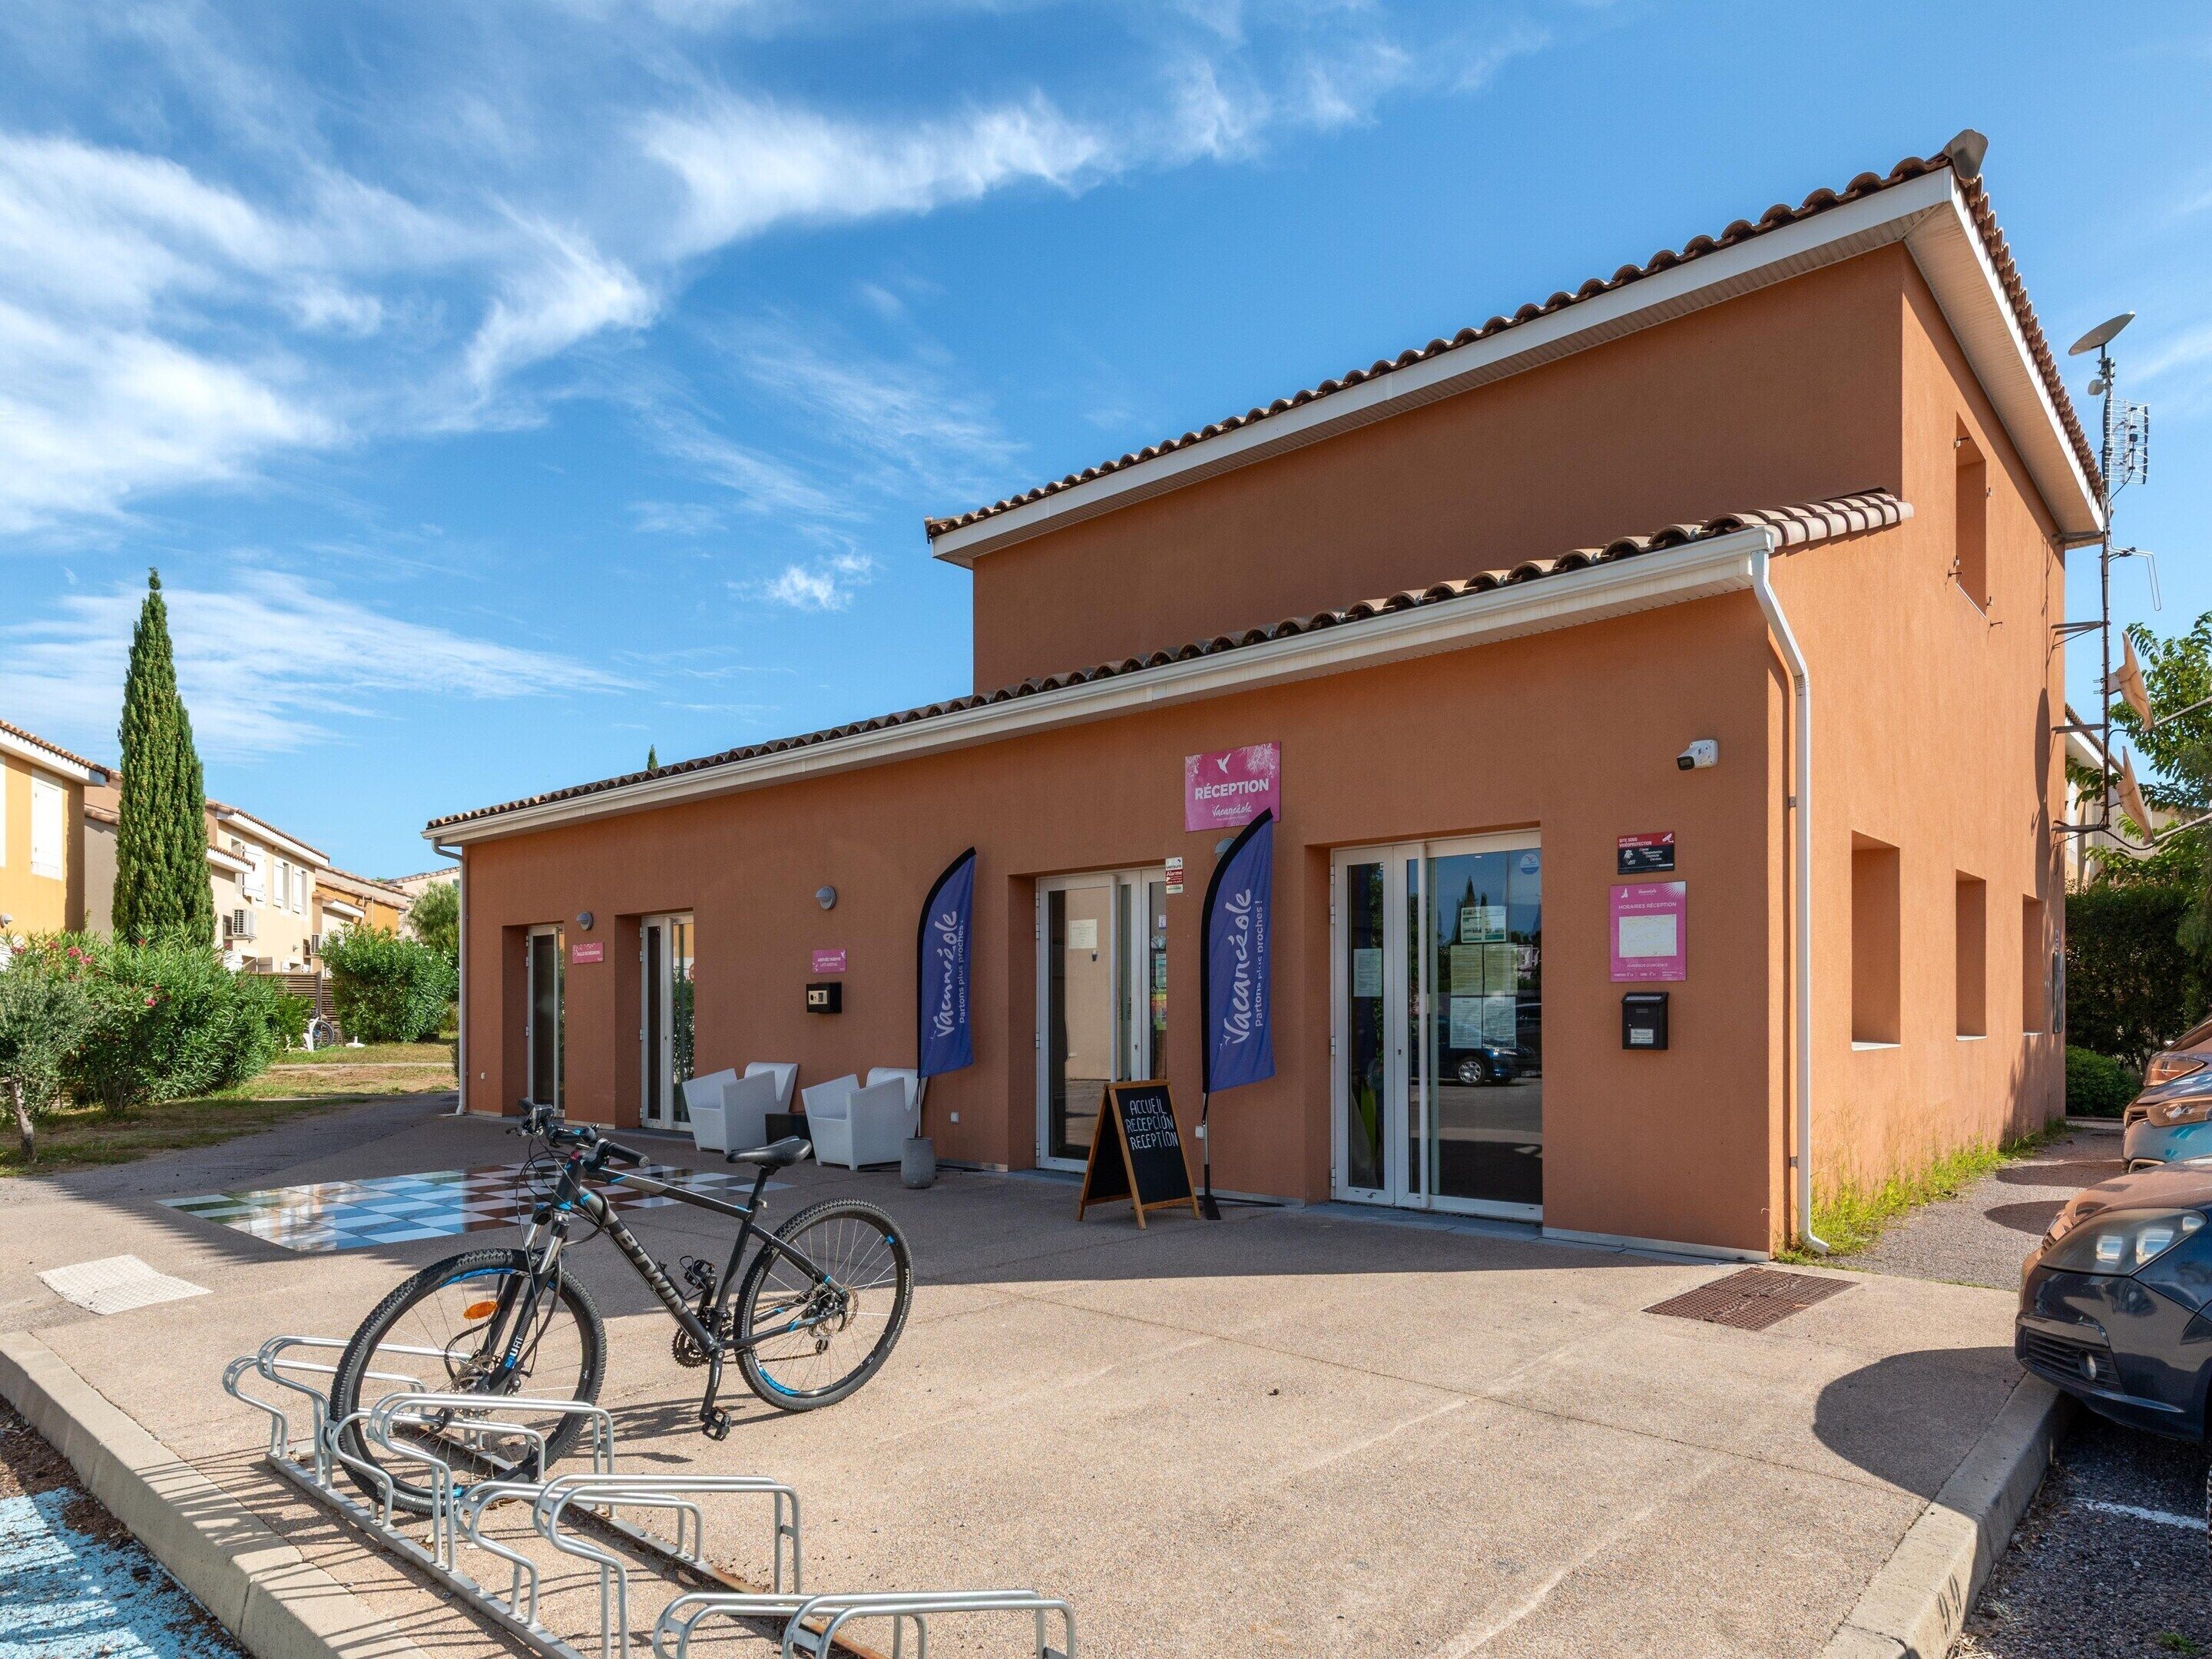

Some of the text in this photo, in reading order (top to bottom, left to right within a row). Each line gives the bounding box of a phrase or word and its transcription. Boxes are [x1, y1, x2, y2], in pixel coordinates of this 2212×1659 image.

[1194, 778, 1269, 800] RÉCEPTION
[1212, 802, 1252, 816] Vacancéole
[1224, 889, 1251, 1044] Vacancéole
[1255, 982, 1263, 1027] Partons
[1130, 1095, 1167, 1115] ACCUEIL
[1130, 1131, 1178, 1151] RECEPTION
